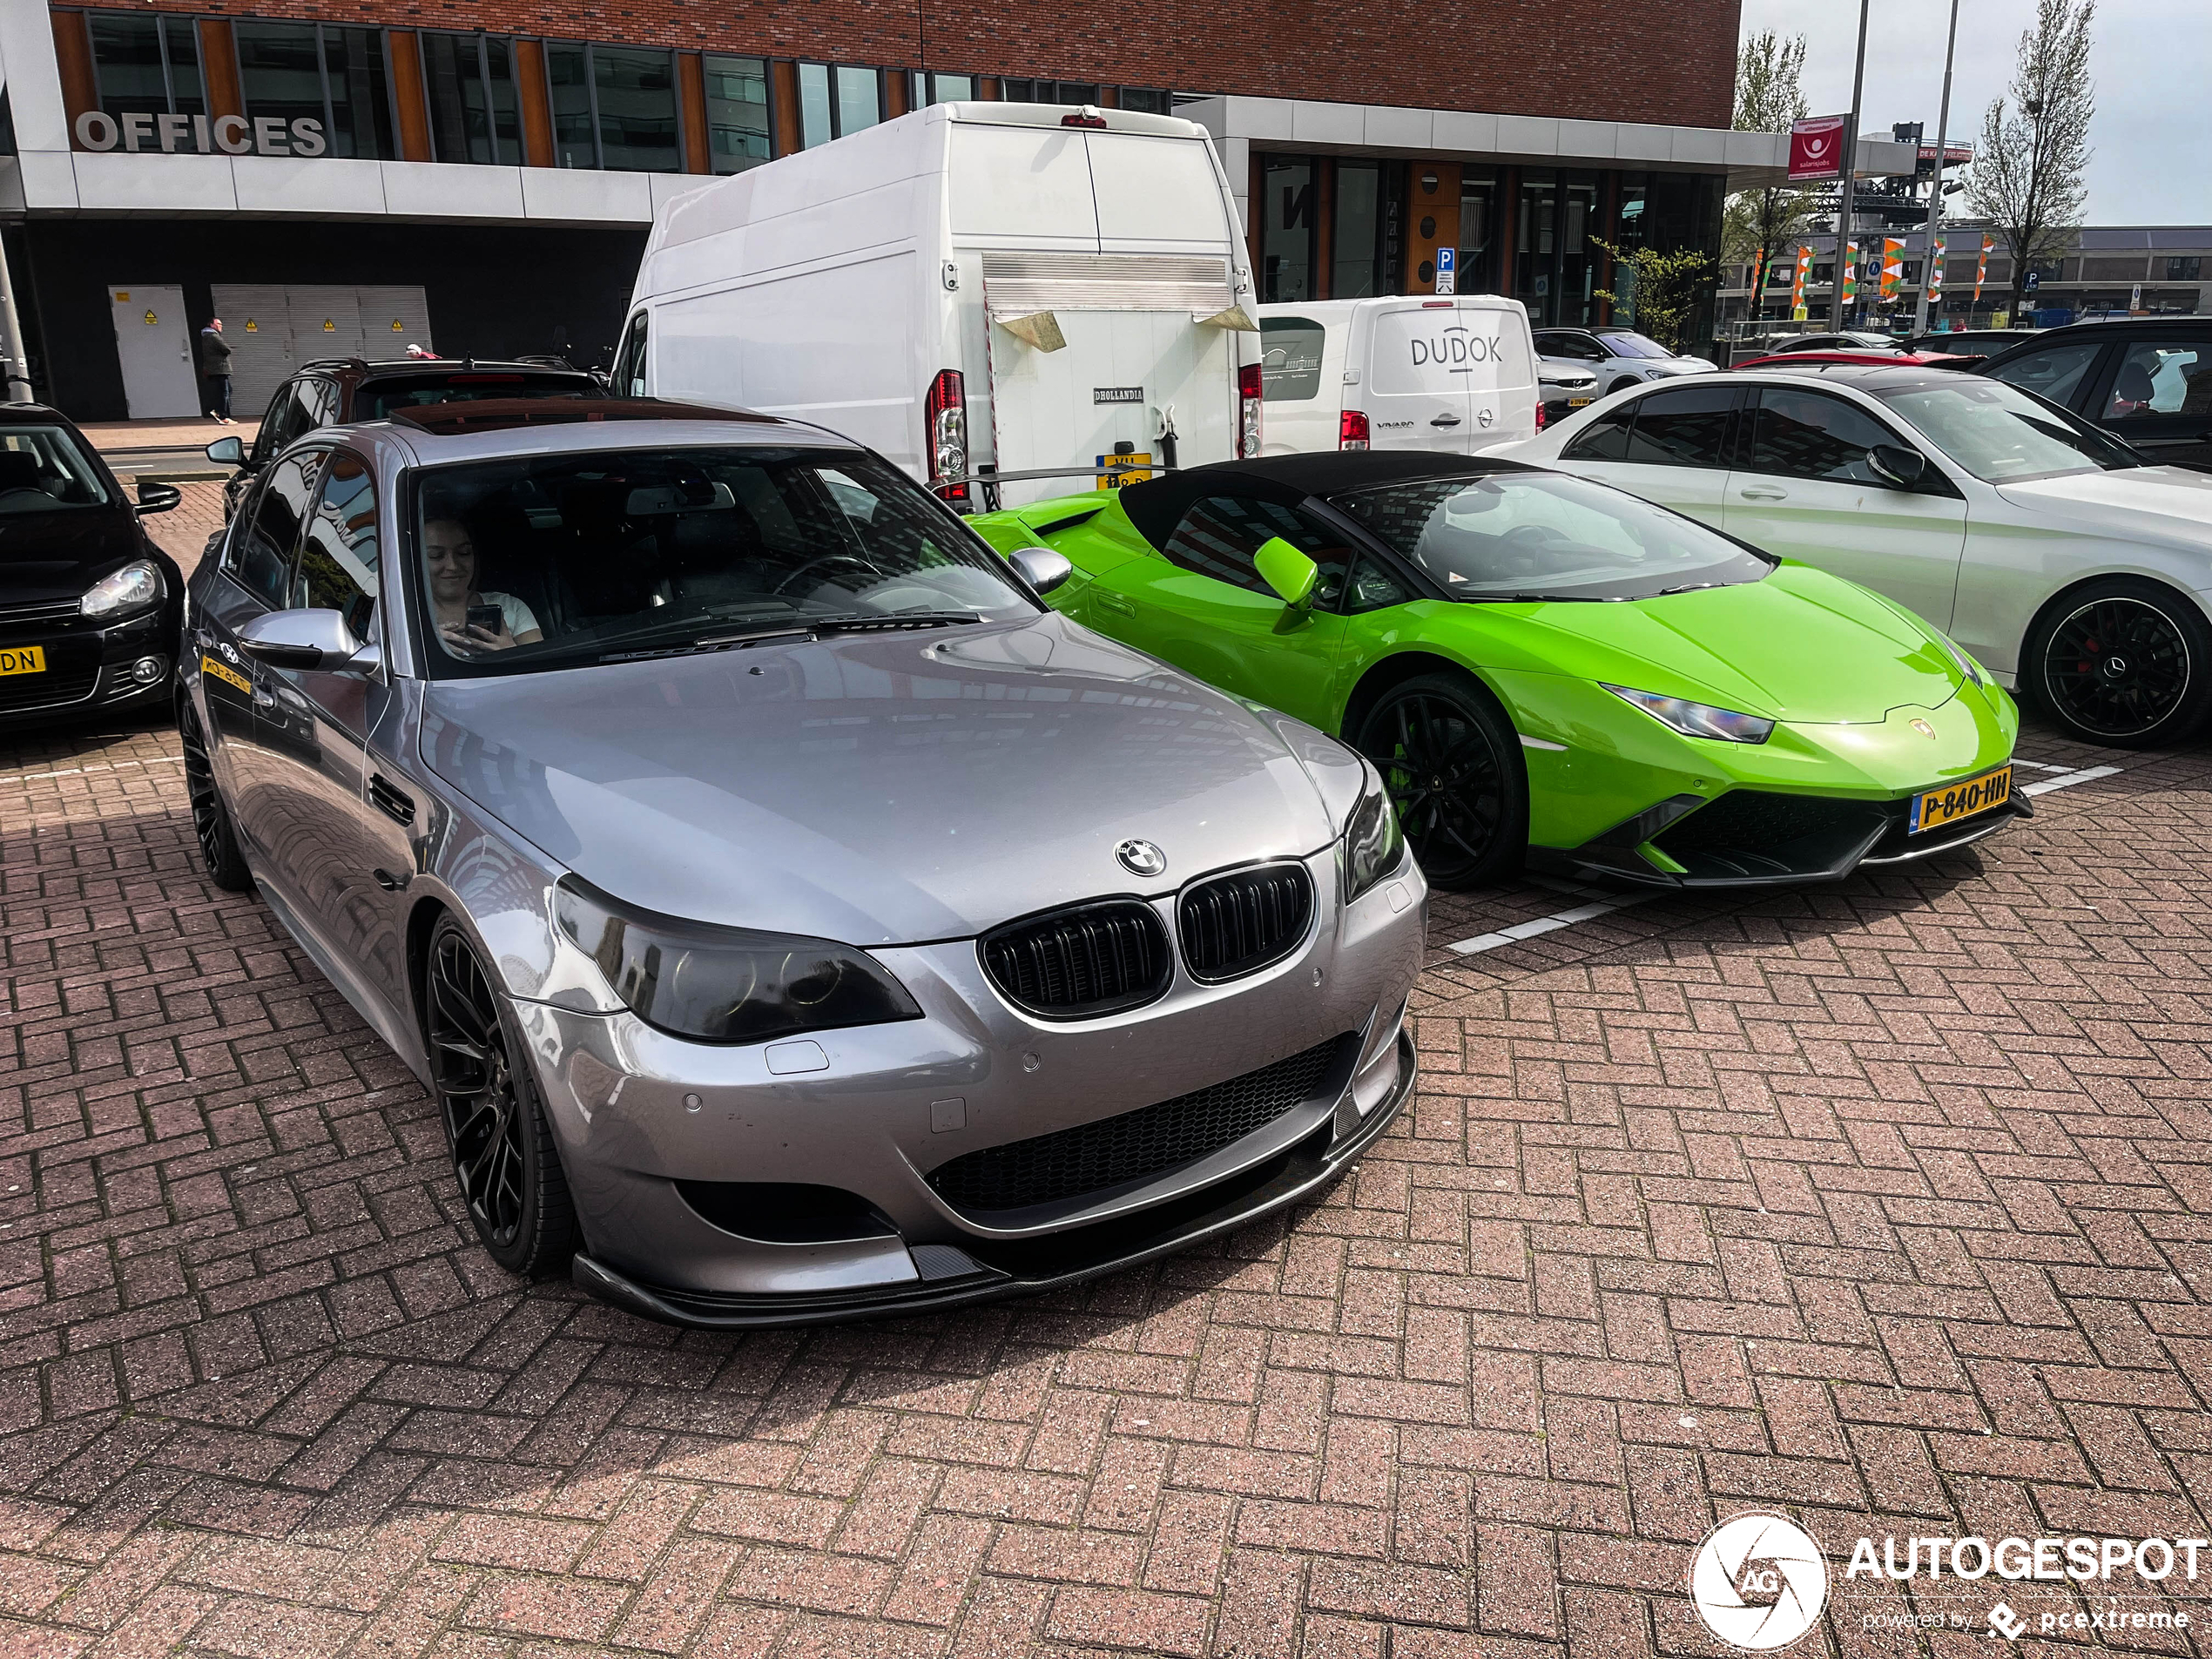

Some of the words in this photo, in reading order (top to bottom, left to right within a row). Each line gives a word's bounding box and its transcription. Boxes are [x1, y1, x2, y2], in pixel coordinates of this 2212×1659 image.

[75, 111, 326, 157] OFFICES
[1441, 252, 1451, 268] P
[2029, 273, 2037, 283] P
[1411, 337, 1502, 366] DUDOK
[1096, 390, 1143, 401] DHOLLANDIA
[1925, 772, 2007, 824] P-840-HH
[1910, 819, 1918, 827] NL
